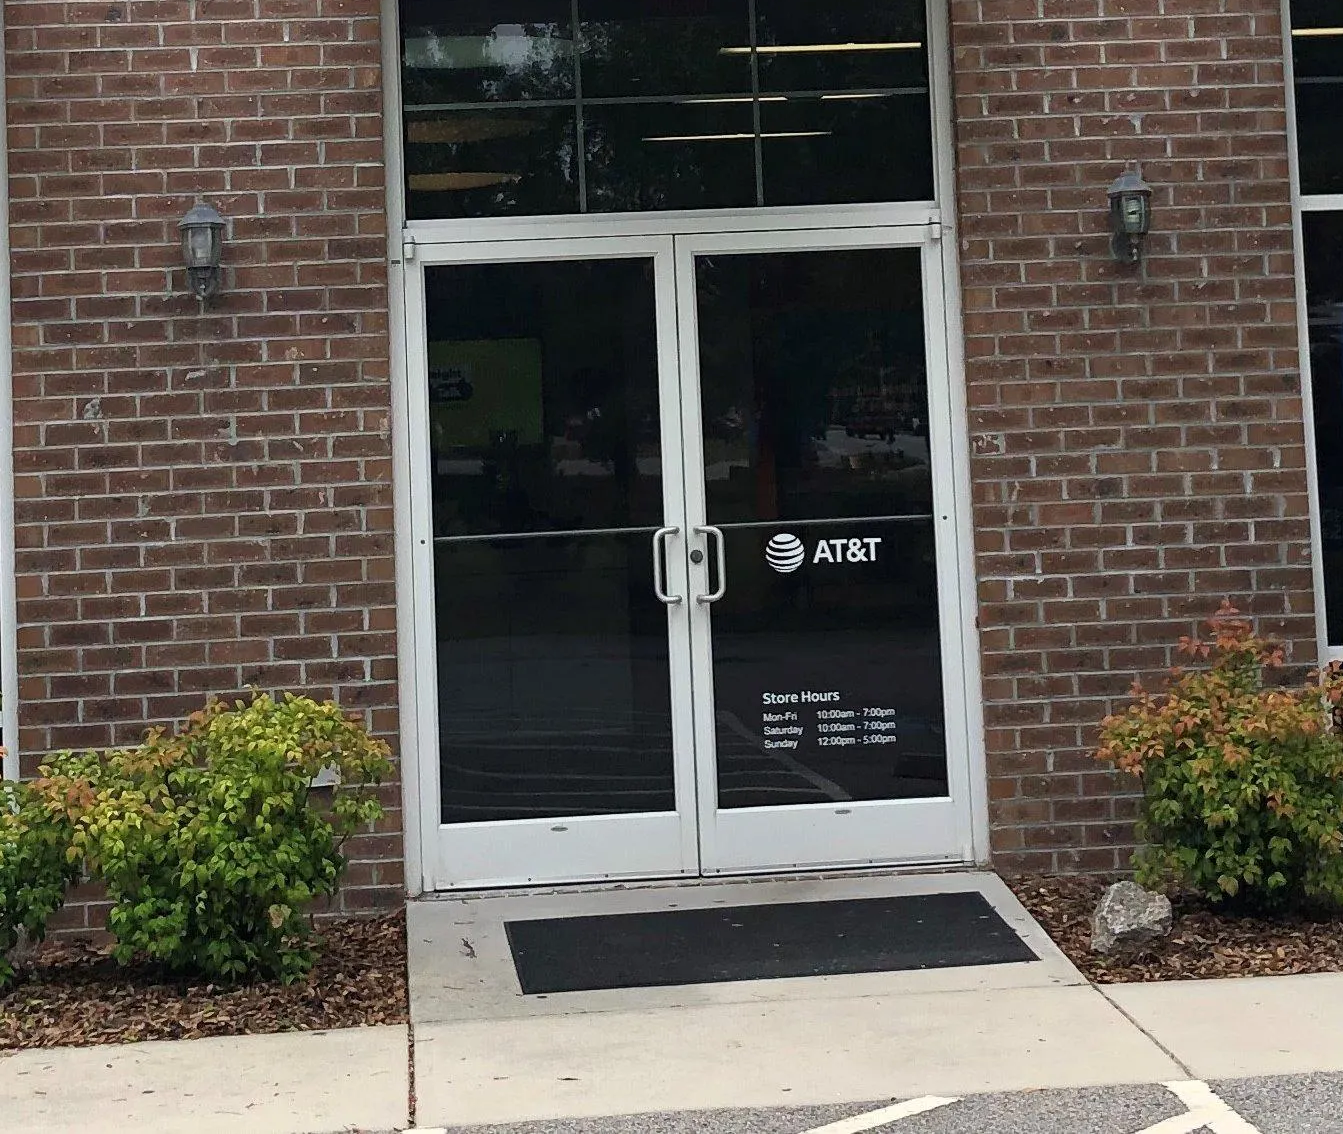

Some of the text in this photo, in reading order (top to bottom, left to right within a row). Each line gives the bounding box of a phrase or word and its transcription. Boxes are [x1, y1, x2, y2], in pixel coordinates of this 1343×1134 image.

[813, 537, 882, 564] AT&T
[762, 690, 840, 705] Store Hours
[763, 711, 798, 722] Mon-Fri
[817, 710, 855, 719] 10:00am
[863, 708, 896, 718] 7:00pm
[763, 725, 803, 736] Saturday
[817, 723, 856, 733] 10:00am
[863, 721, 896, 731] 7:00pm
[764, 739, 798, 749] Sunday
[817, 736, 856, 746] 12:00pm
[863, 734, 897, 744] 5:00pm
